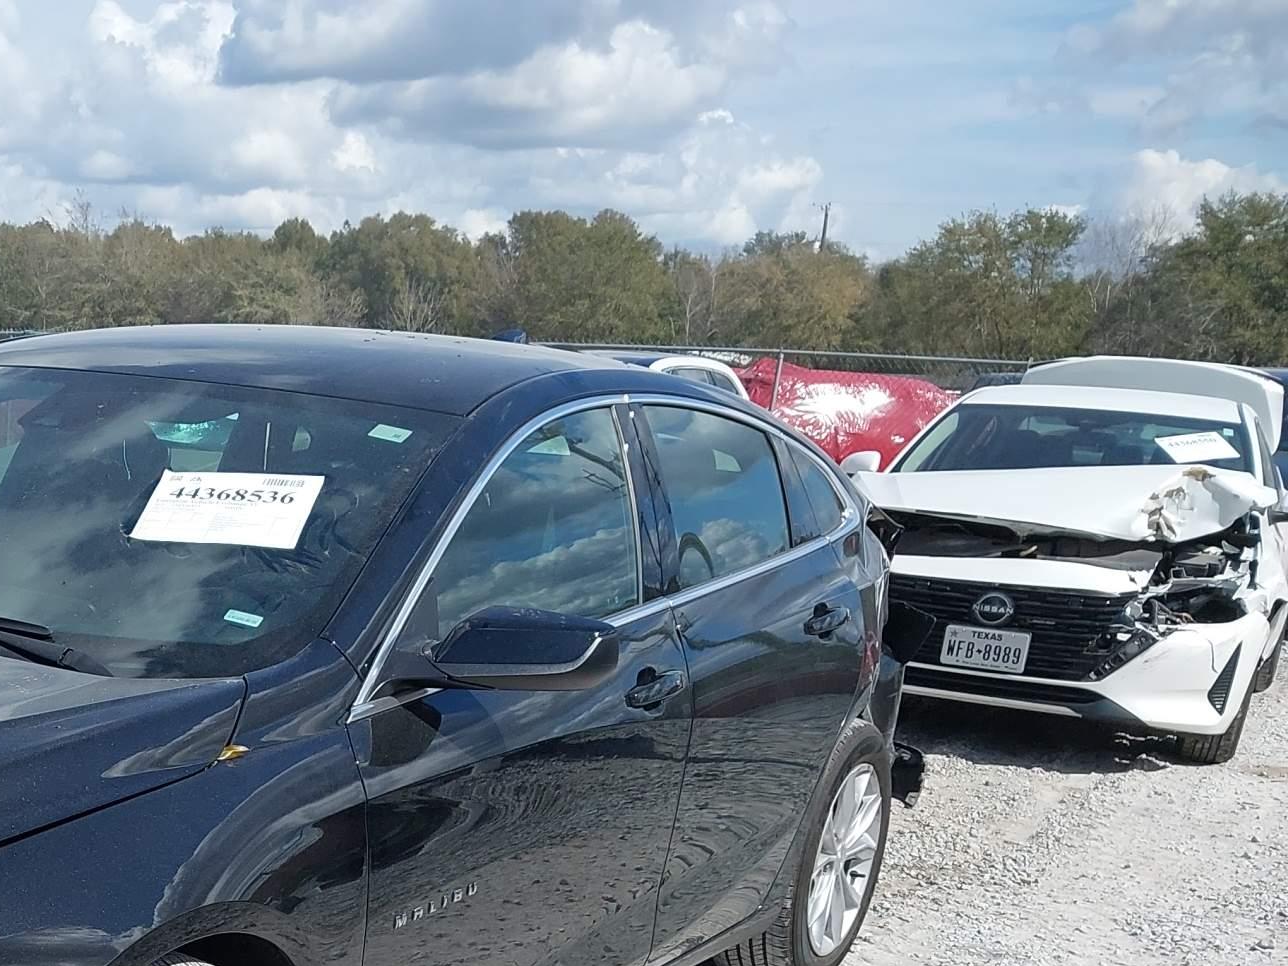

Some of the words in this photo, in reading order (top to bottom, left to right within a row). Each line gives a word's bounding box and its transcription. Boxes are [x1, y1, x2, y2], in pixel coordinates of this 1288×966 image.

[169, 486, 296, 505] 44368536
[972, 603, 1014, 616] NISSAN
[971, 630, 1003, 642] TEXAS
[394, 881, 478, 930] MALIBU
